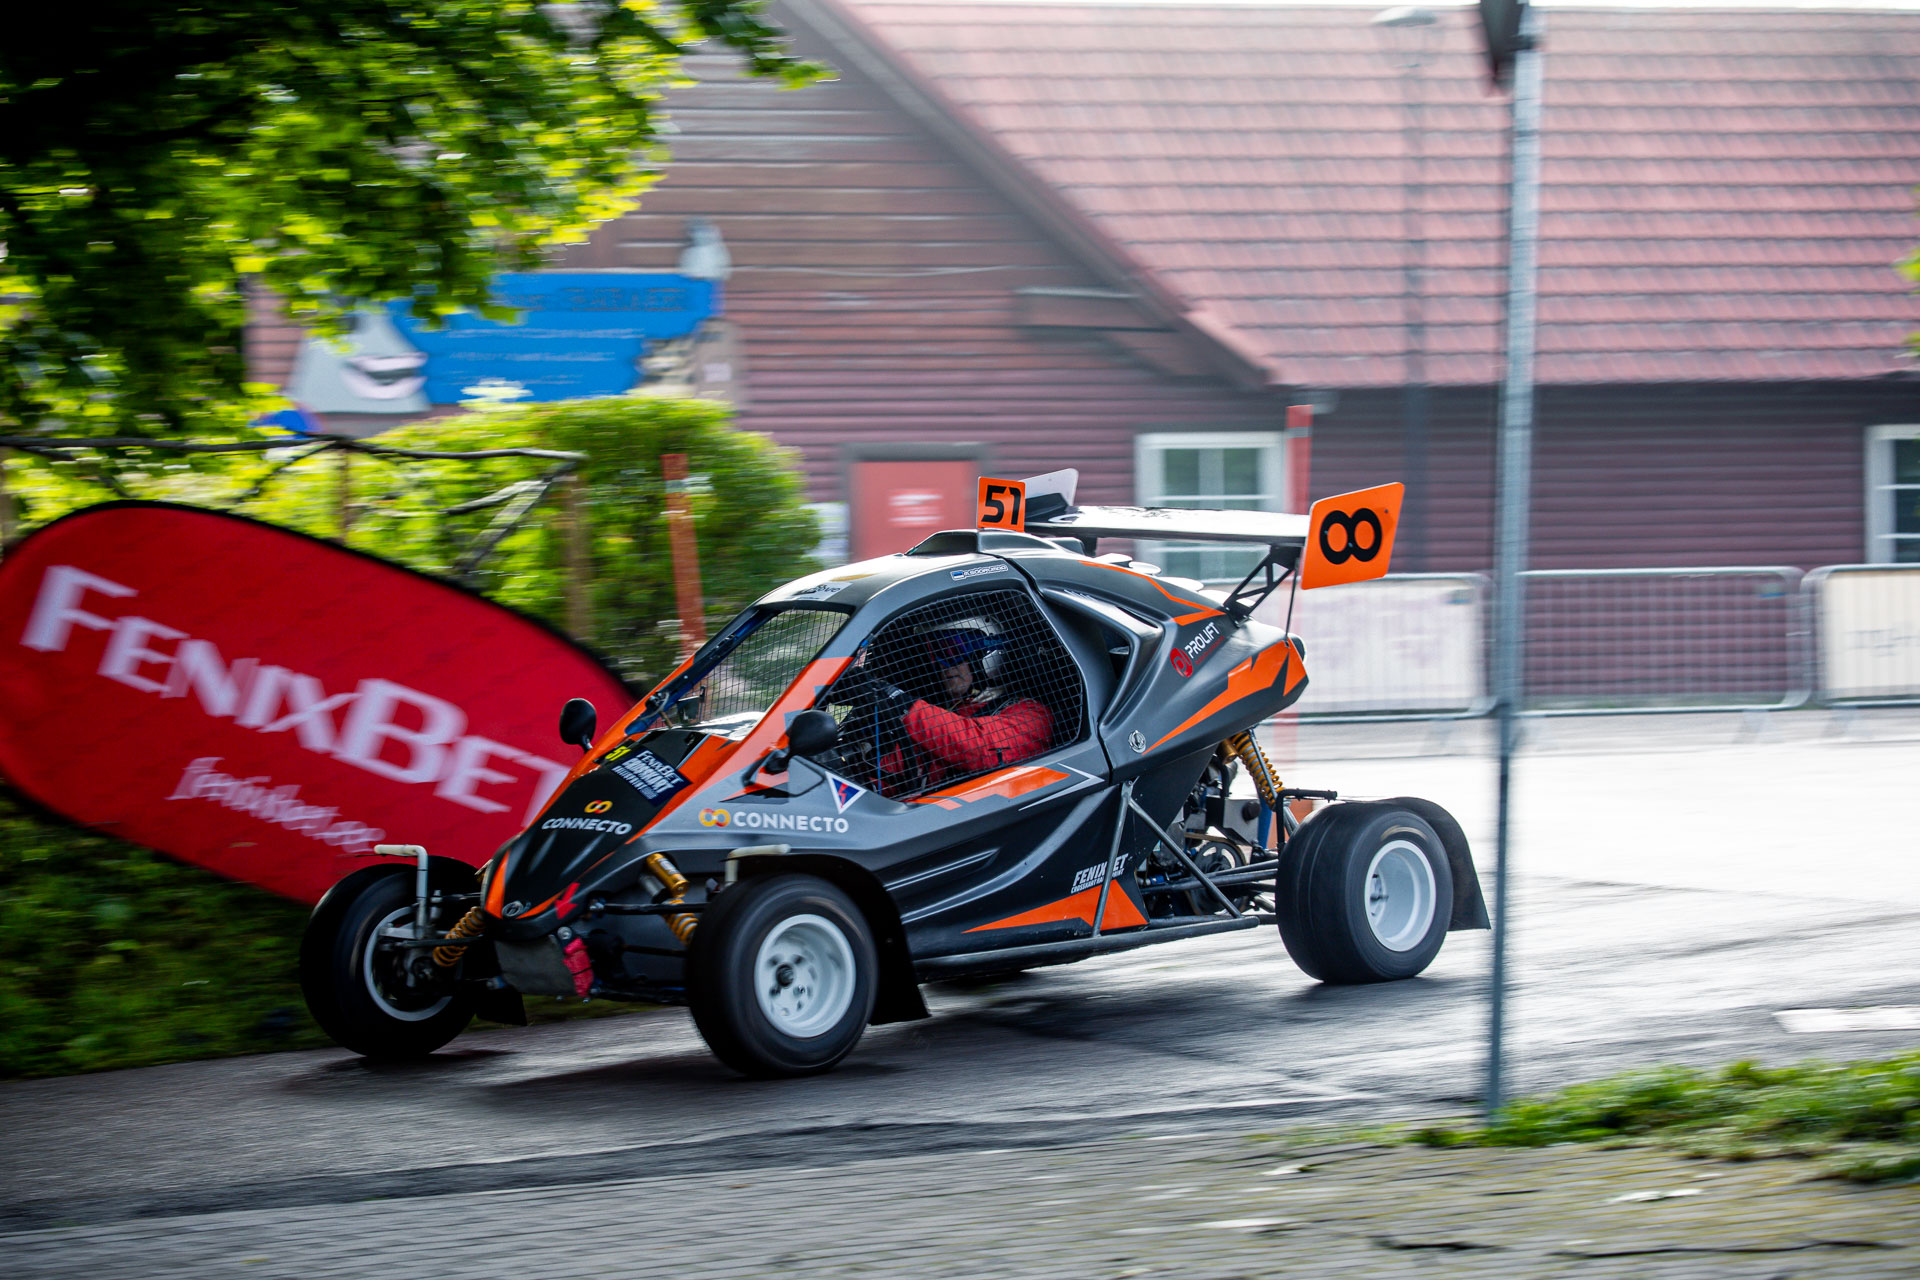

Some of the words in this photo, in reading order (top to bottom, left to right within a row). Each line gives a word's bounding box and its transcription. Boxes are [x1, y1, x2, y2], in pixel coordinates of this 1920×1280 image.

[981, 485, 1021, 525] 51
[1184, 621, 1220, 659] PROLIFT
[604, 746, 632, 761] 51
[541, 817, 632, 835] CONNECTO
[733, 811, 849, 833] CONNECTO
[1072, 853, 1129, 887] FENIXET
